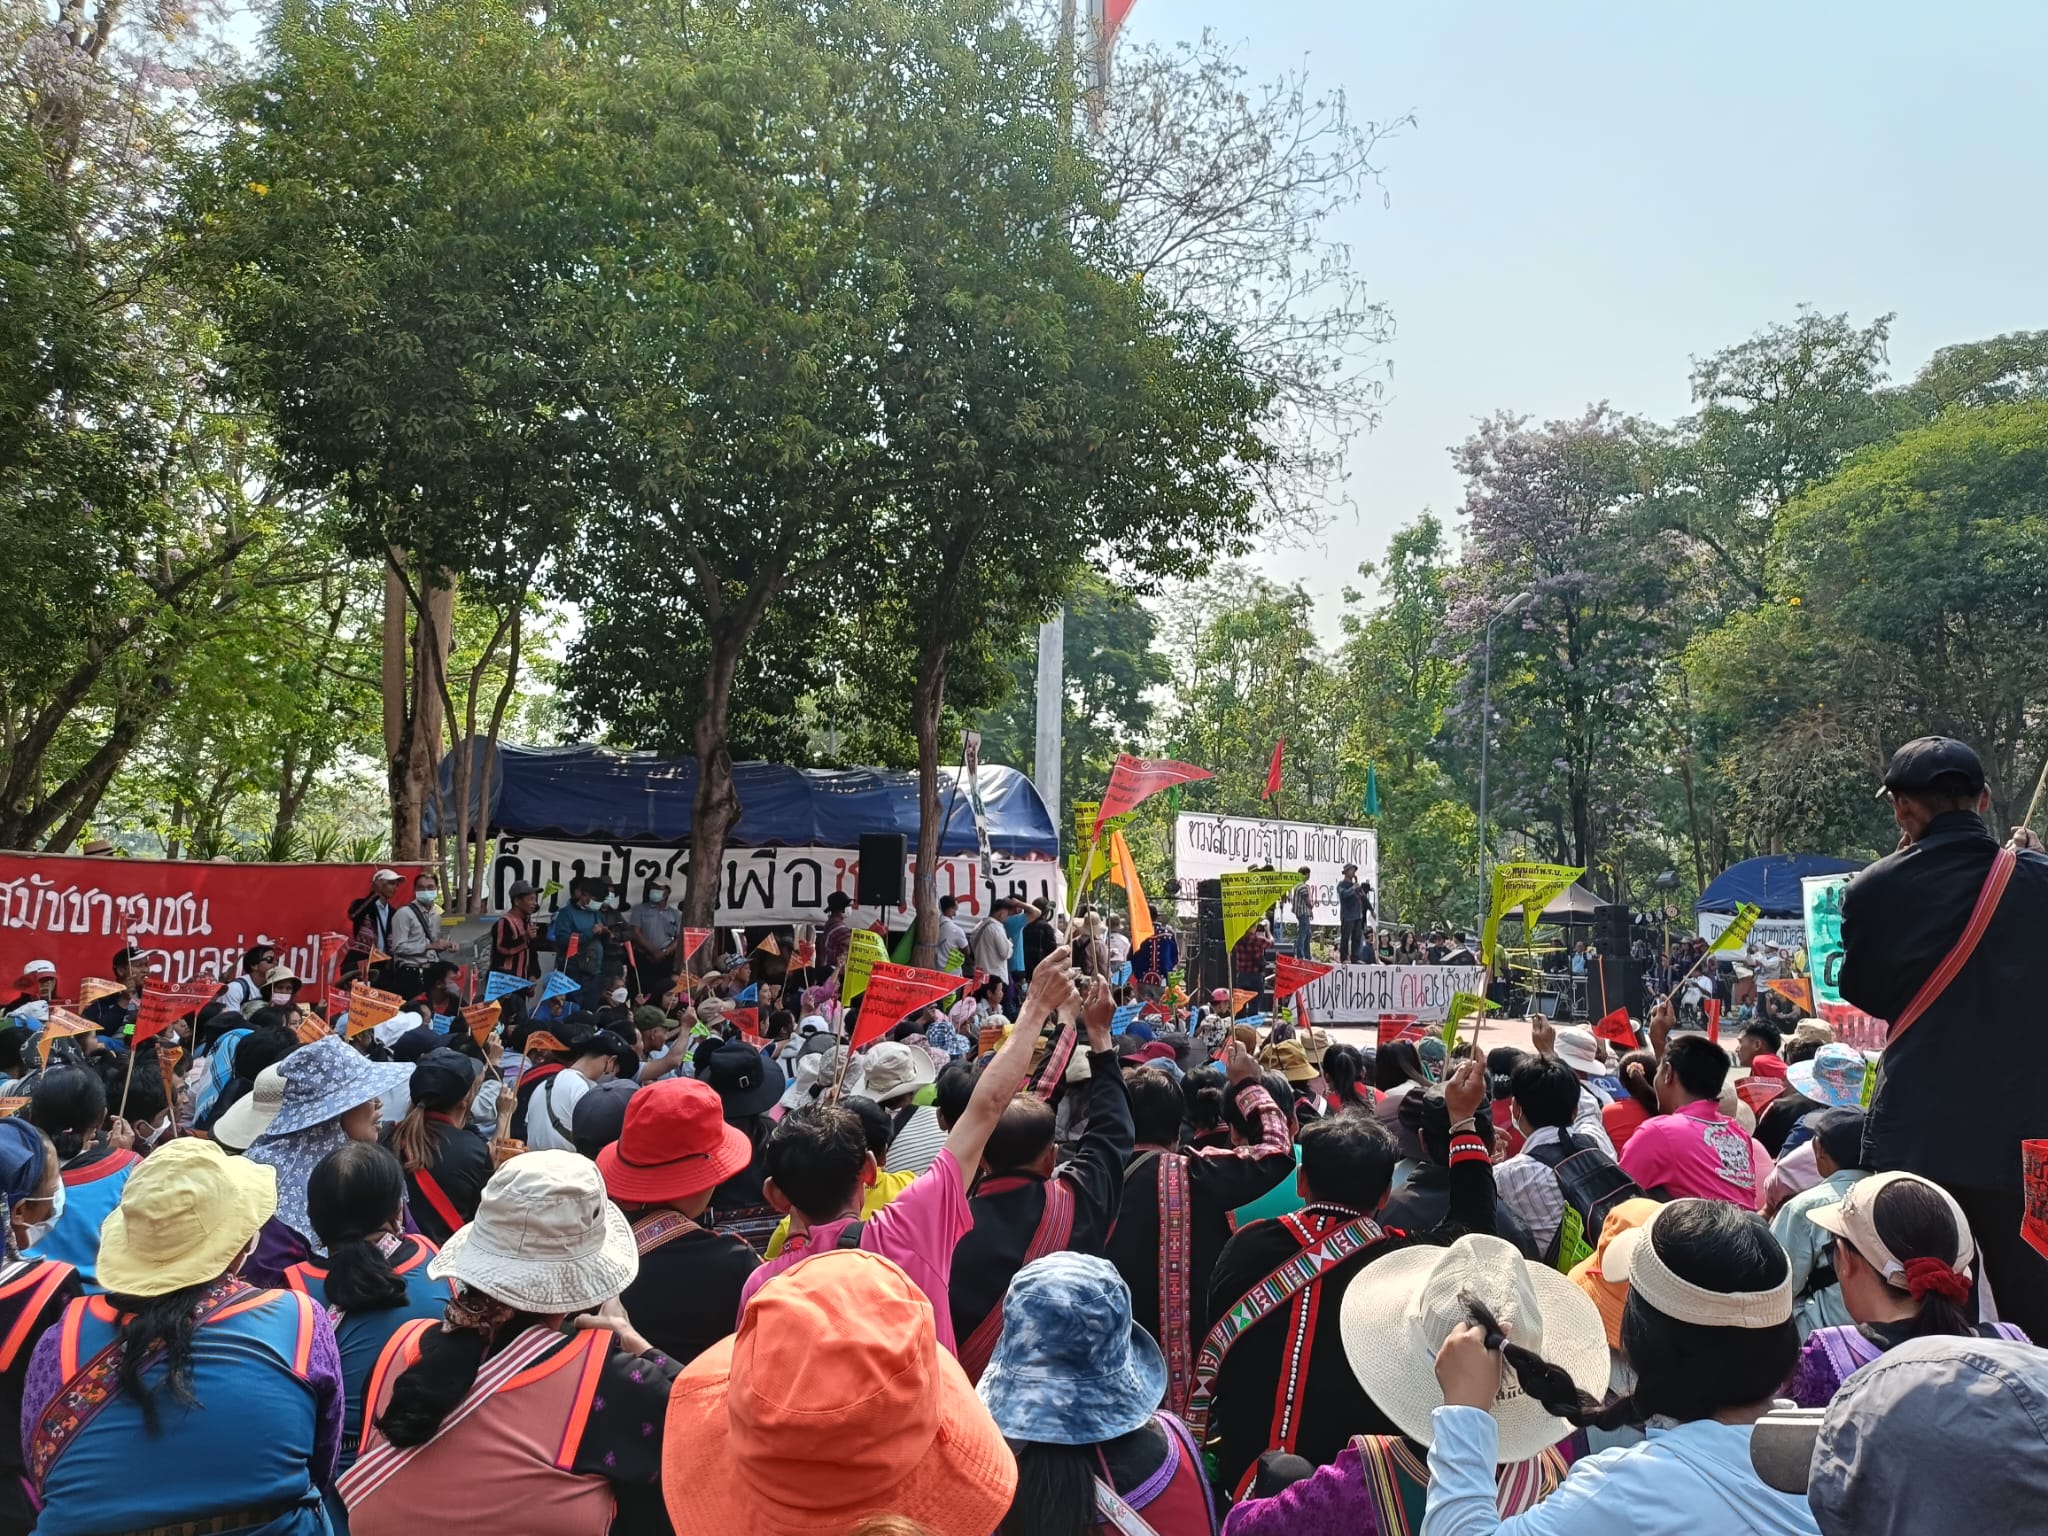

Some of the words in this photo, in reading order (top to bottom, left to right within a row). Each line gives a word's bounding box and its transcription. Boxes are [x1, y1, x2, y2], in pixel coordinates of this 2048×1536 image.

[1188, 817, 1299, 865] ทวงสัญญารัฐบาล
